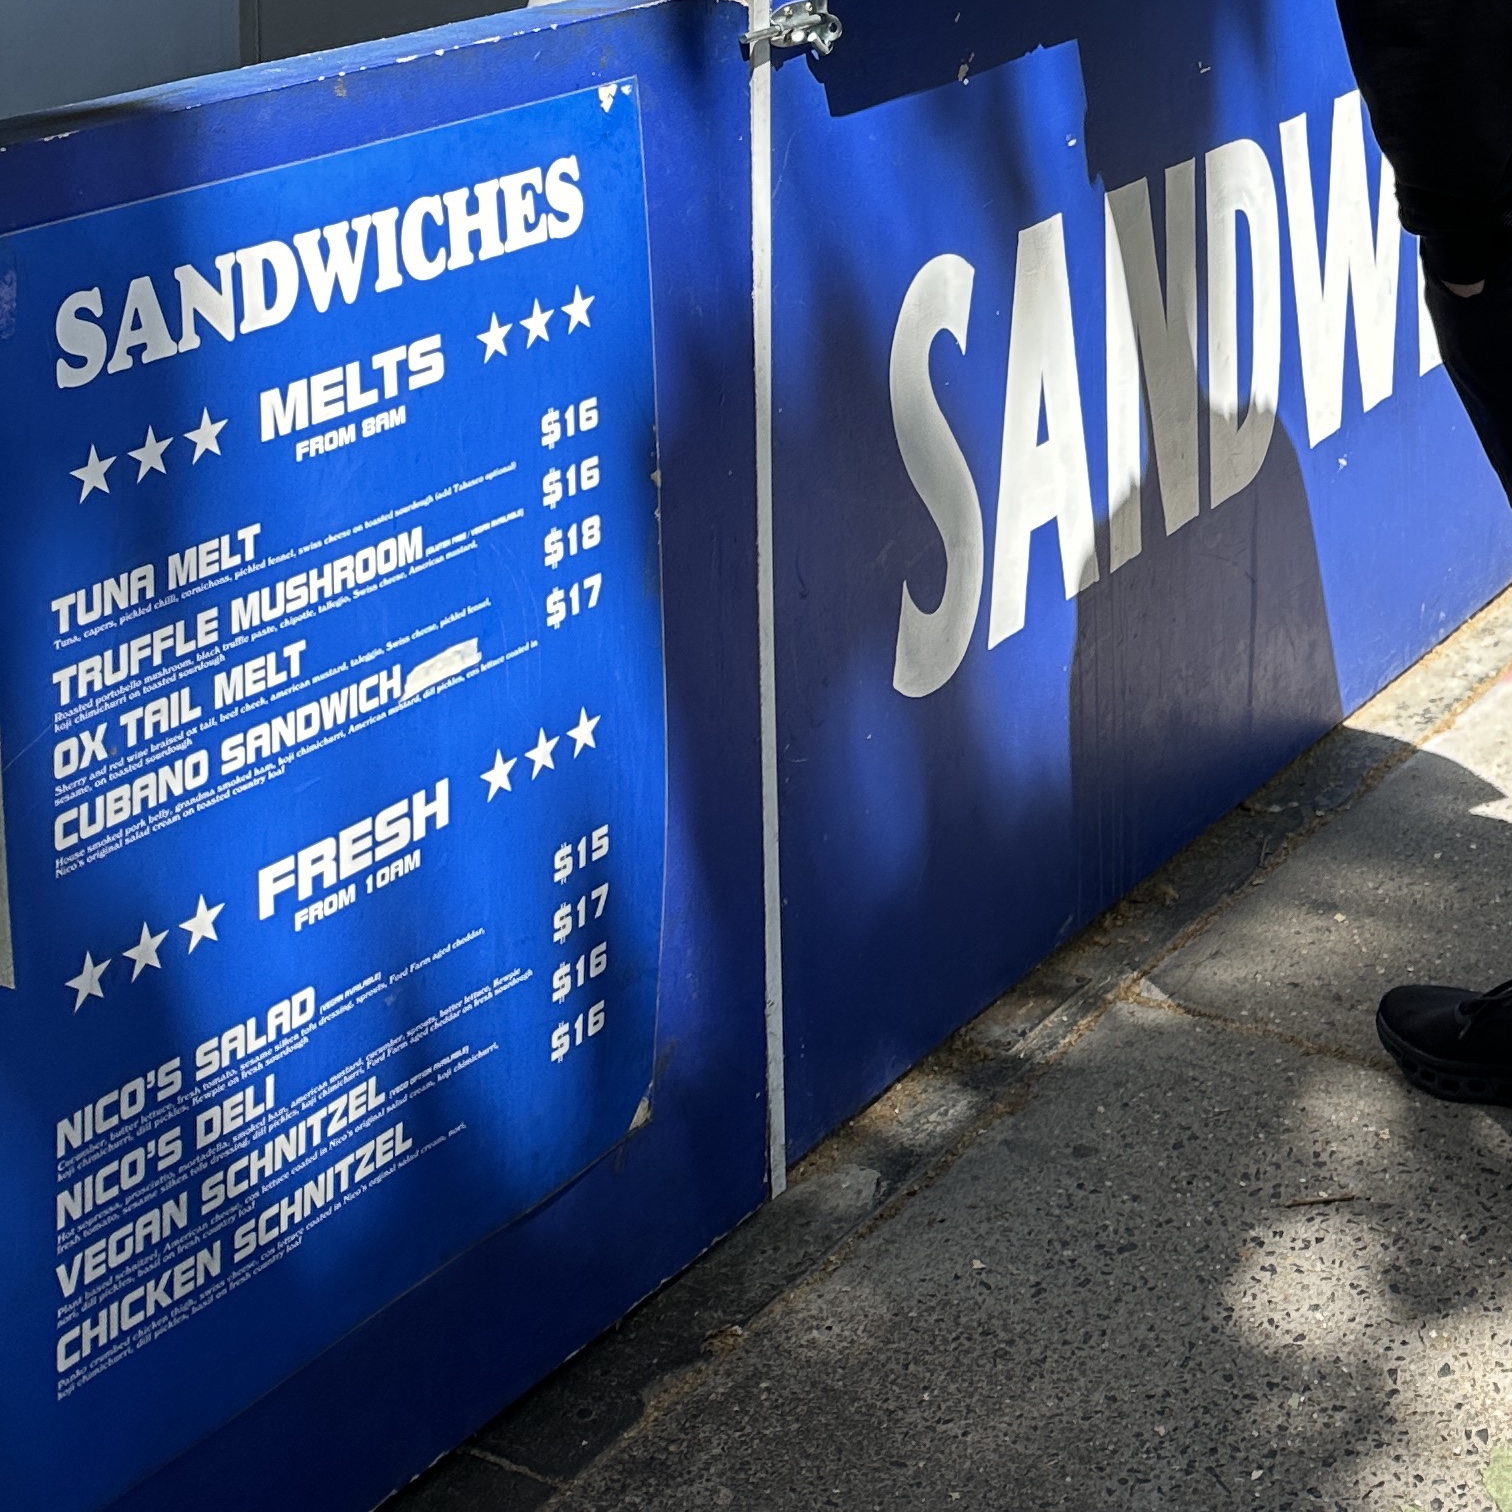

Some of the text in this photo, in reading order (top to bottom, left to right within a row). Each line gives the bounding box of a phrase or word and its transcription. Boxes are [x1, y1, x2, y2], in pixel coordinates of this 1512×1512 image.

[54, 153, 584, 389] SANDWICHES
[259, 332, 445, 443] MELTS
[294, 404, 407, 462] FROM 8AM
[540, 395, 599, 450] $16
[541, 454, 600, 510] $16
[50, 522, 261, 635] TUNA MELT
[543, 513, 601, 570] $18
[51, 605, 219, 707] TRUFFLE
[230, 525, 423, 635] MUSHROOM
[545, 571, 602, 630] $17
[52, 638, 307, 780] OX TAIL MELT
[53, 662, 402, 851] CUBANO SANDWICH
[257, 776, 449, 921] FRESH
[293, 848, 421, 932] FROM 10AM
[552, 823, 609, 885] $15
[552, 881, 609, 945] $17
[551, 940, 607, 1005] $16
[55, 1055, 182, 1159] NICO'S
[194, 985, 315, 1082] SALAD
[549, 999, 605, 1063] $16
[54, 1074, 386, 1298] VEGAN SCHNITZEL
[55, 1072, 275, 1231] NICO'S DELI
[55, 1120, 413, 1373] CHICKEN SCHNITZEL
